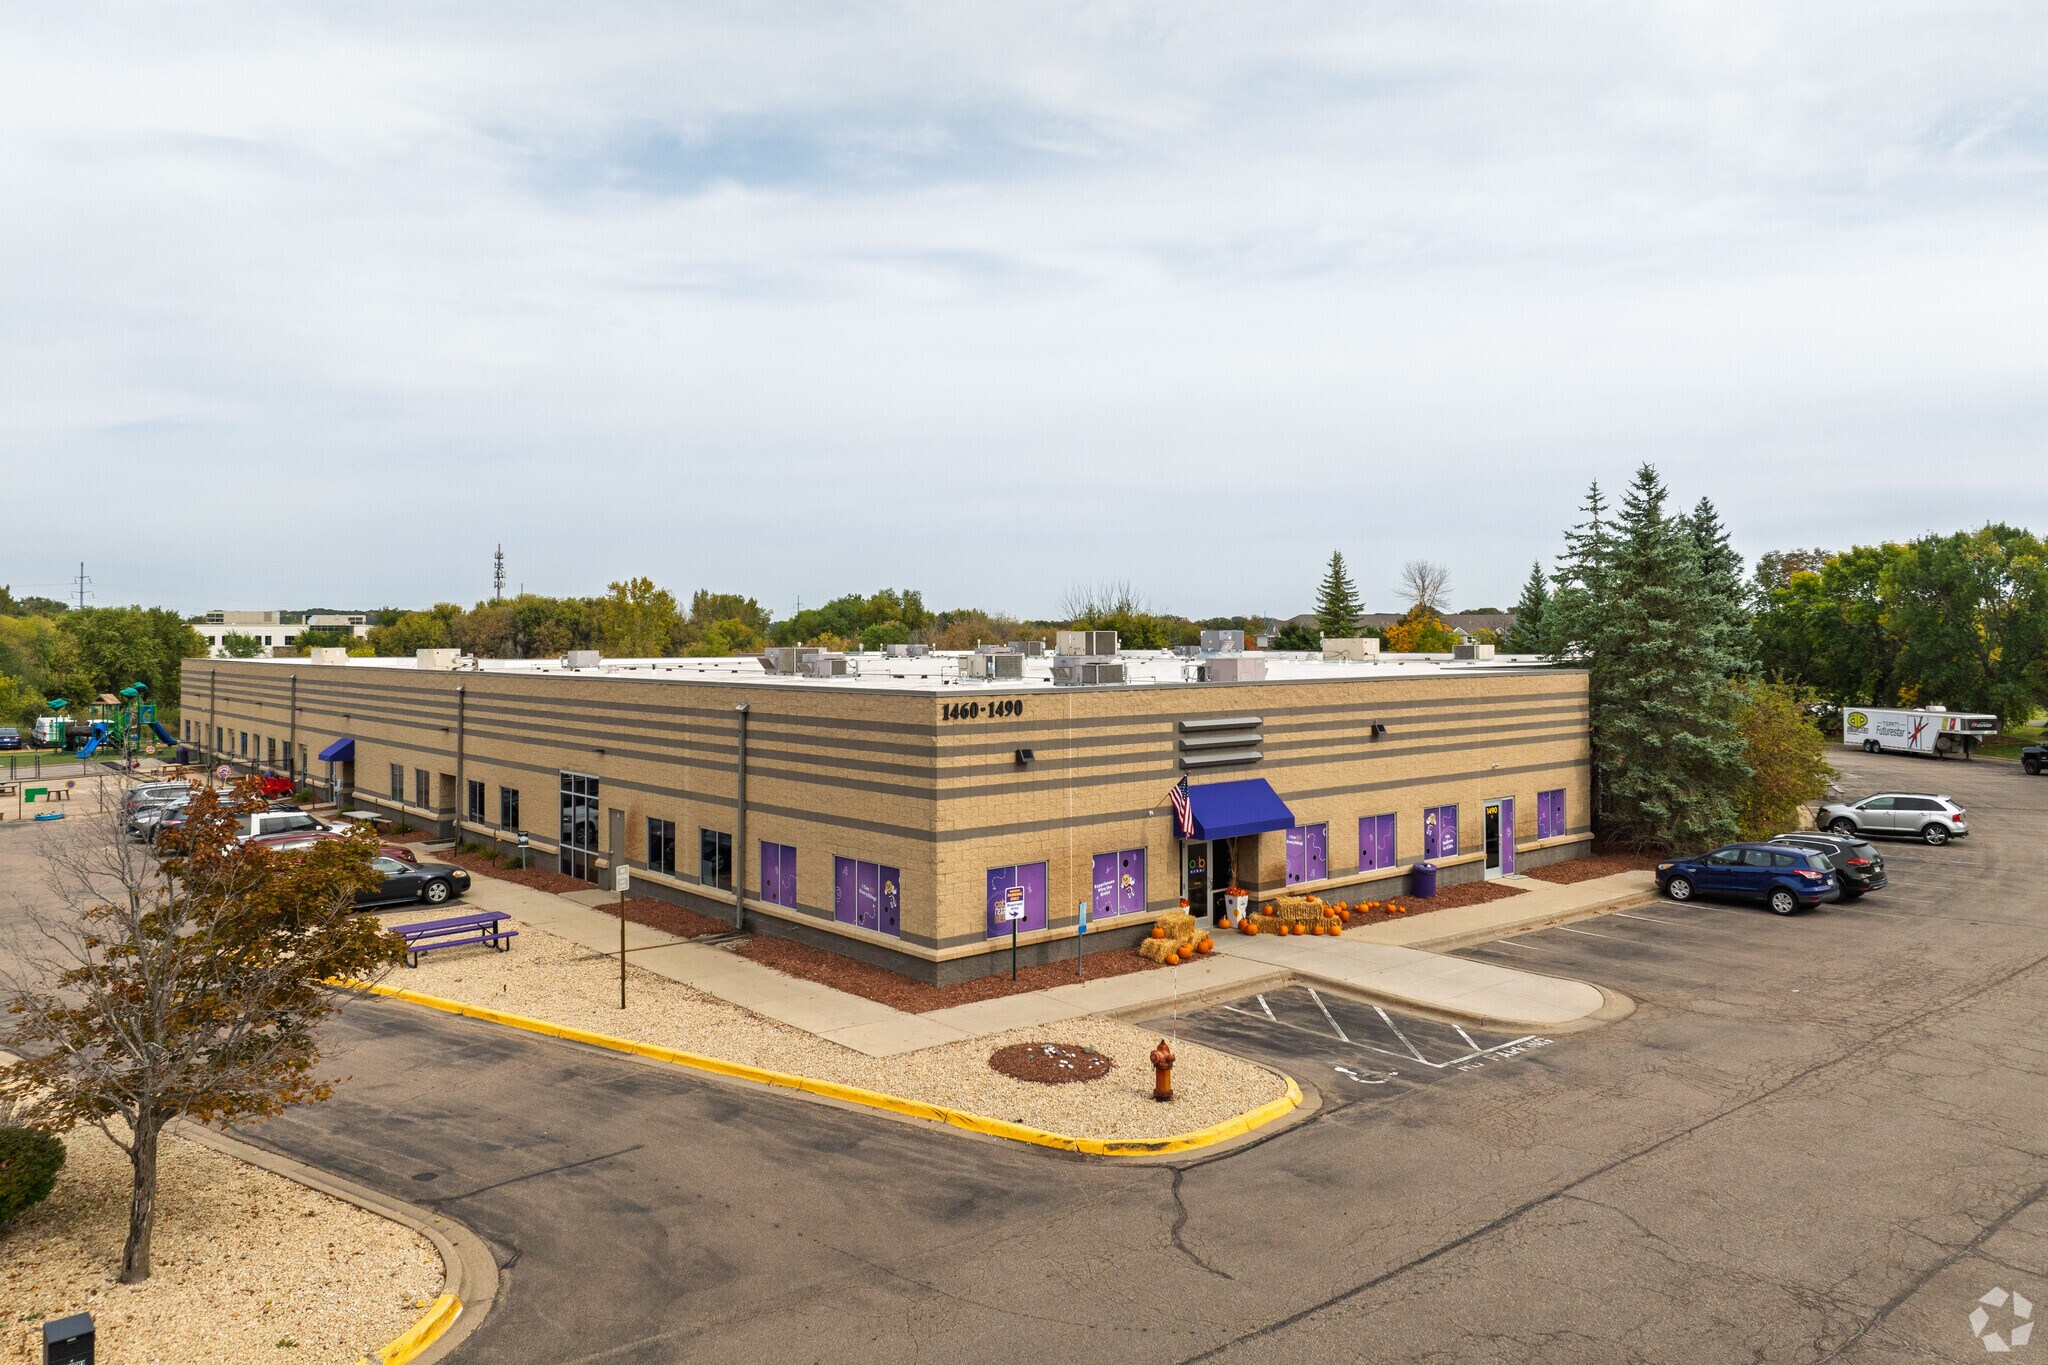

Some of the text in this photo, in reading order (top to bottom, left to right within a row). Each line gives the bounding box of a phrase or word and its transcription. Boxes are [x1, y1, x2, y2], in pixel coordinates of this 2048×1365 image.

[942, 699, 1023, 720] 1460-1490
[1876, 725, 1905, 737] Futurestar
[1486, 806, 1497, 814] 1490
